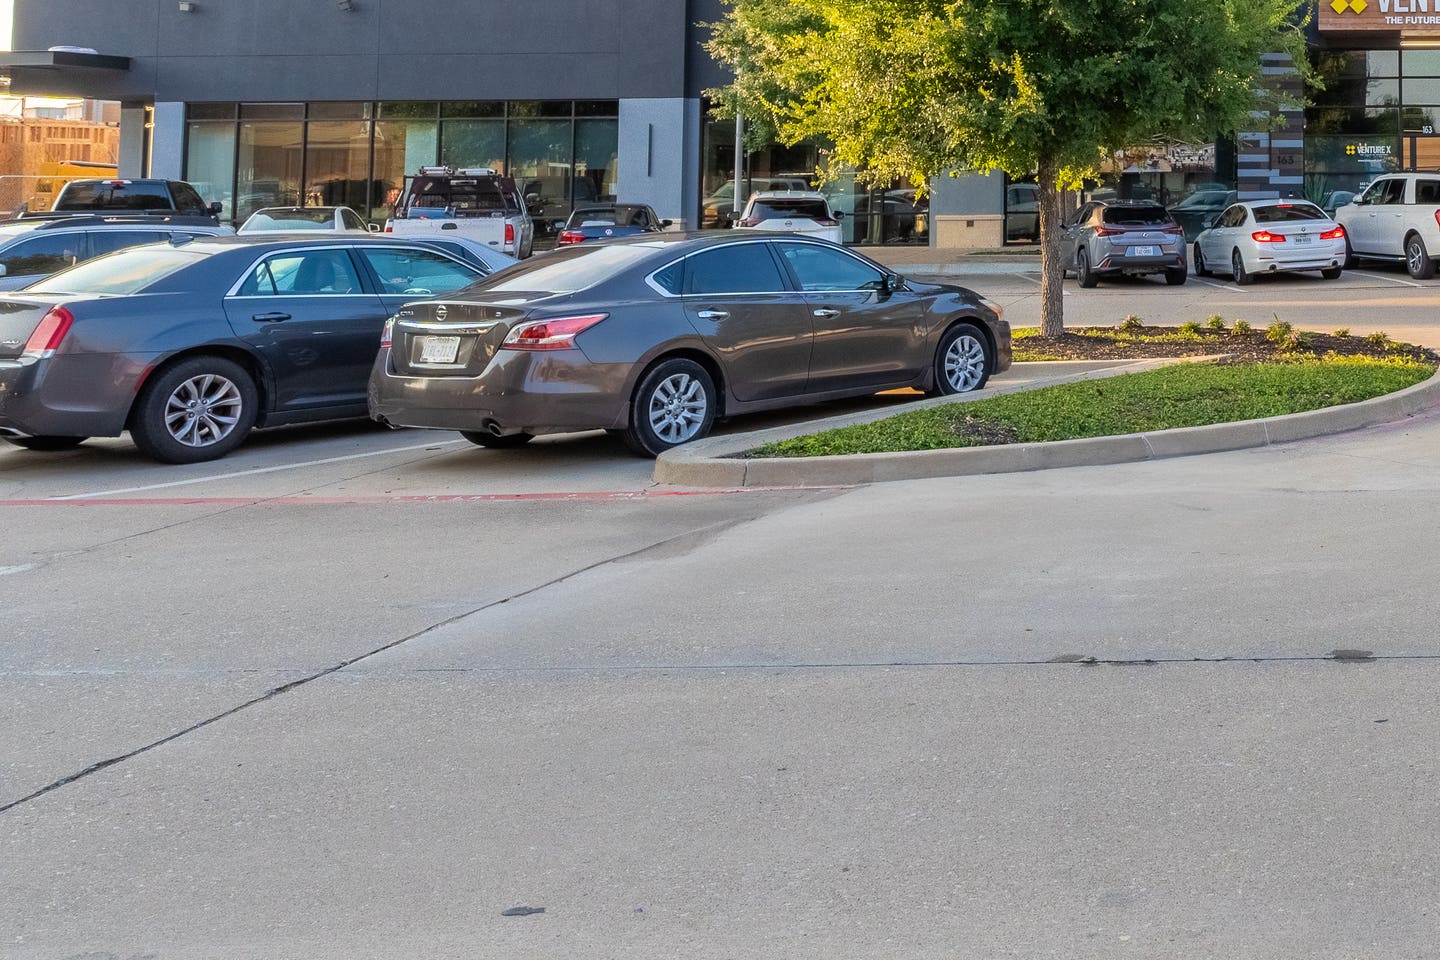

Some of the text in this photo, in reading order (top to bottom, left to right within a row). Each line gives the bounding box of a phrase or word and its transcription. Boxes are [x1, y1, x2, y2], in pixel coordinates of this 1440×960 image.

[1385, 16, 1403, 25] THE
[1422, 125, 1433, 134] 163
[1357, 145, 1391, 154] VENTURE X
